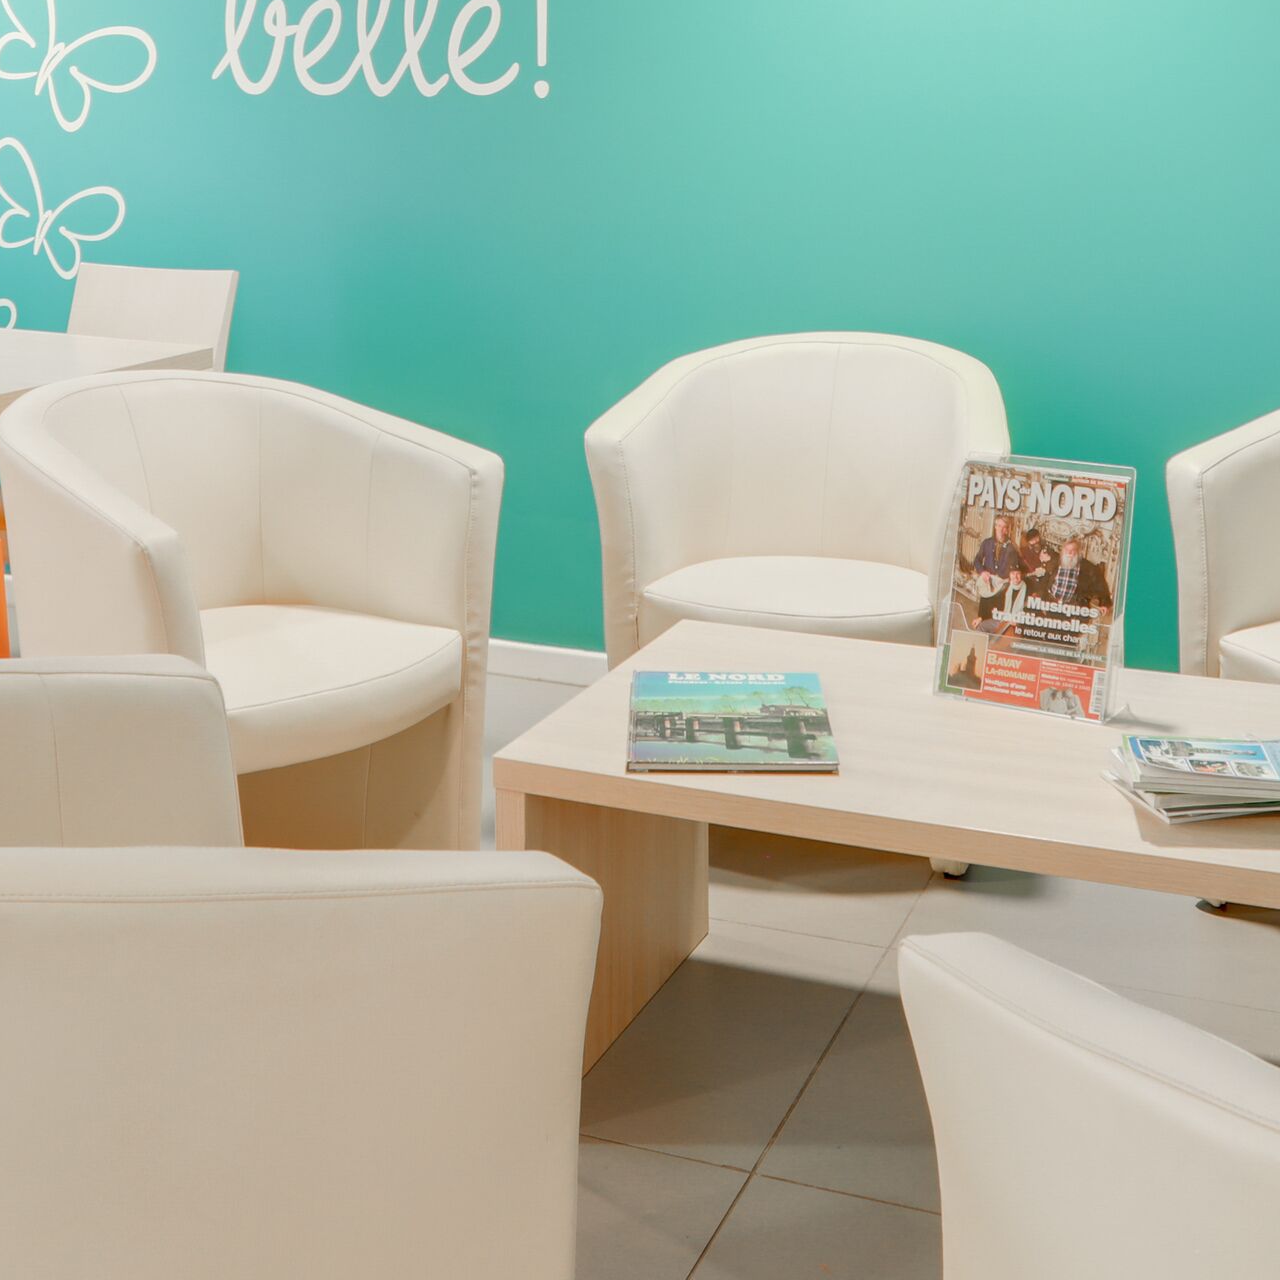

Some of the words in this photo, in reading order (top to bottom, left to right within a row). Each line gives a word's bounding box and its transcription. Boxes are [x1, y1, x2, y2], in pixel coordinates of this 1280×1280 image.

[967, 474, 1022, 511] PAYS
[1028, 481, 1118, 523] NORD
[1027, 596, 1100, 619] Musiques
[992, 607, 1099, 635] traditionnelles
[1023, 628, 1046, 640] retour
[1047, 633, 1062, 641] aux
[667, 672, 701, 681] LE
[707, 673, 785, 681] NORD
